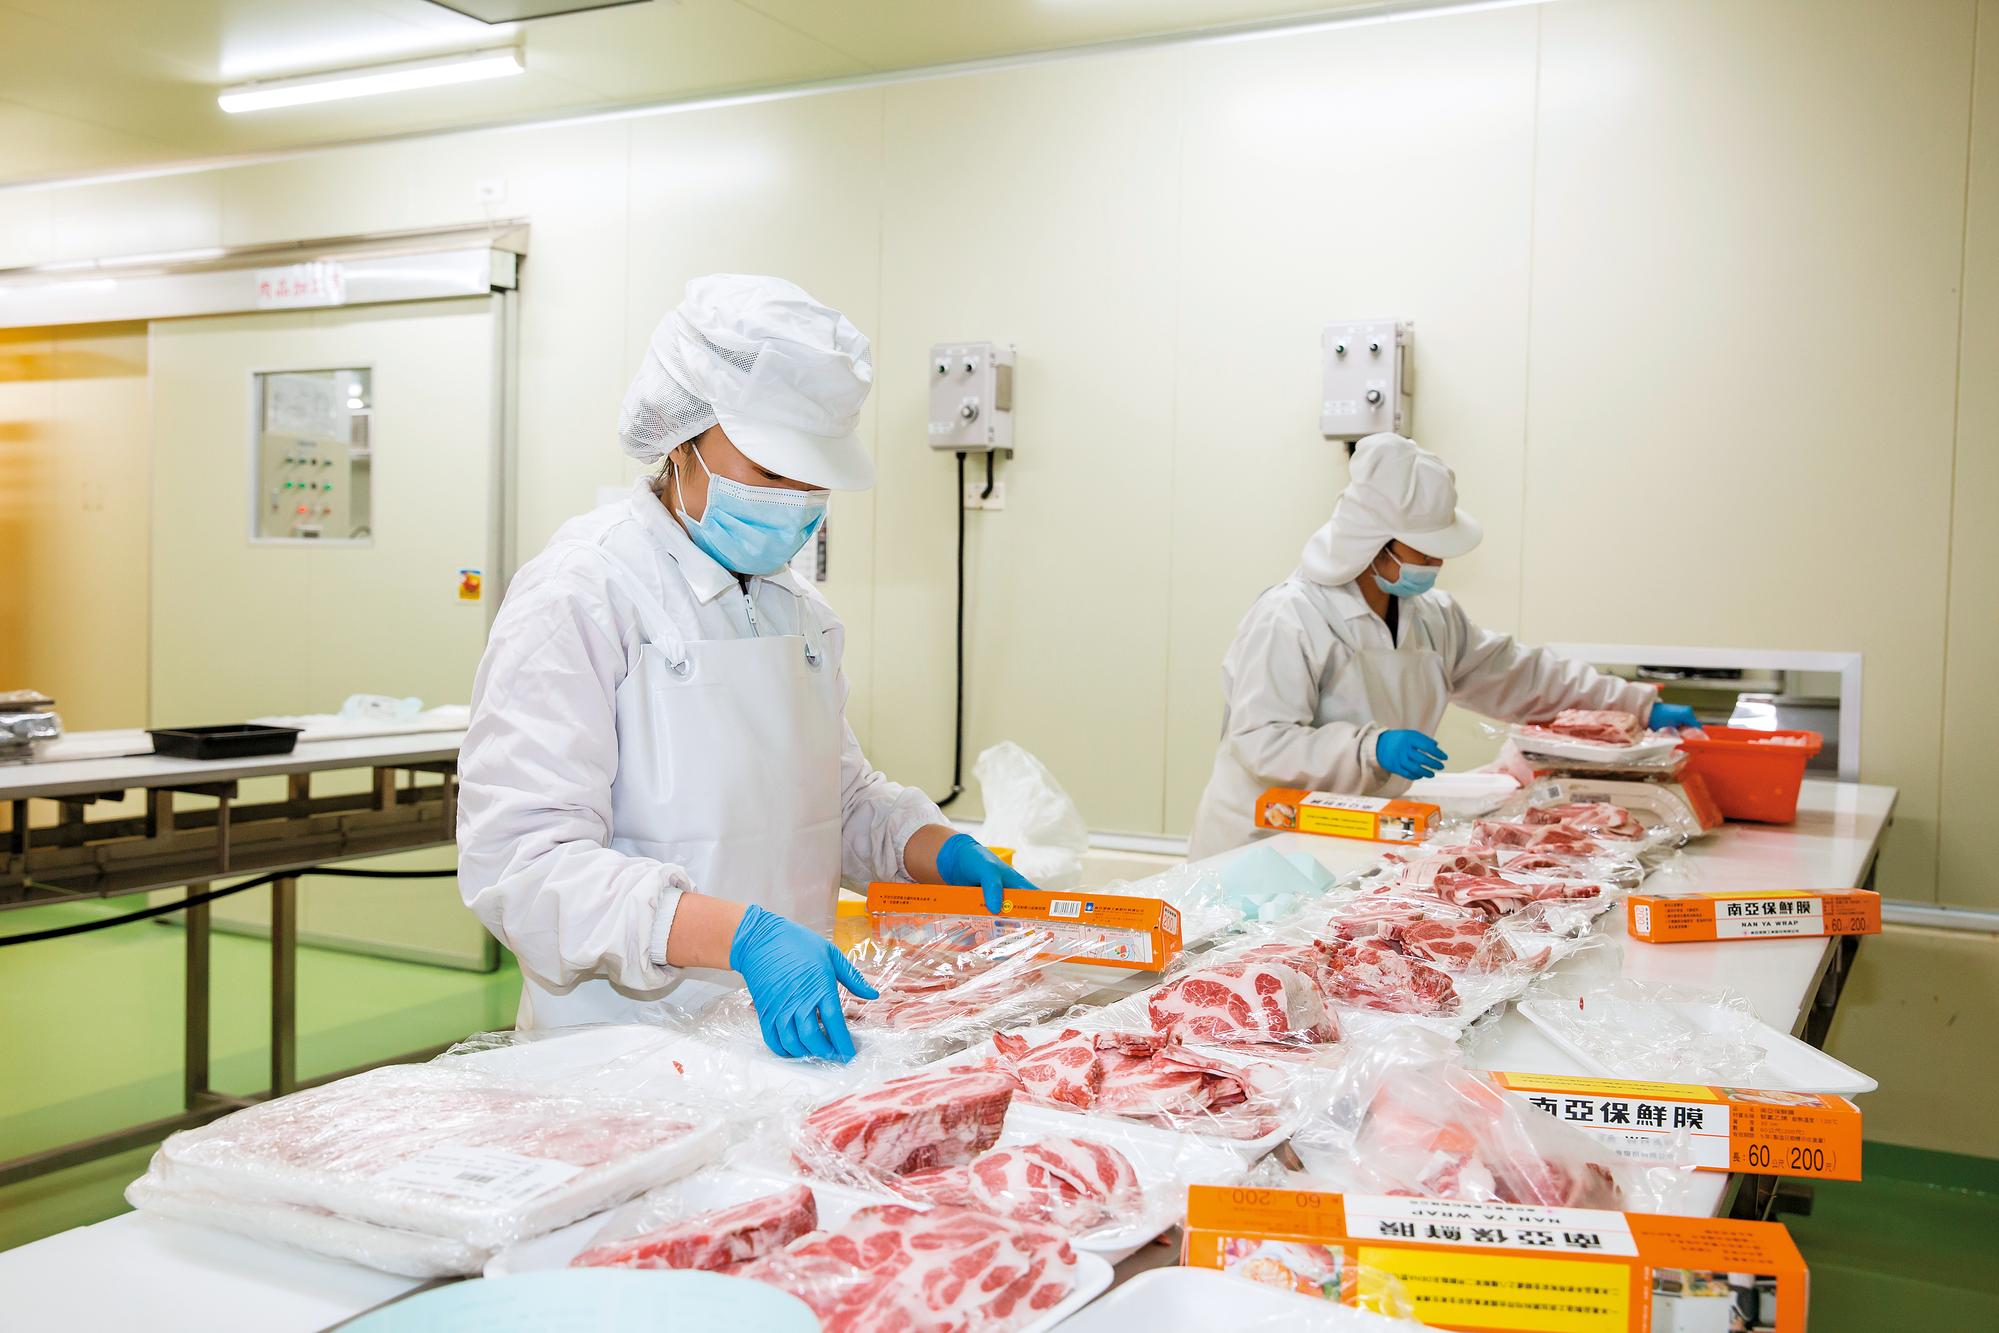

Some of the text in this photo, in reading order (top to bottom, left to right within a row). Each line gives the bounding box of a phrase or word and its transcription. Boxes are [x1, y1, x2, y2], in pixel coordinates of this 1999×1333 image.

[1727, 901, 1811, 916] 南亞保鮮膜
[1851, 918, 1866, 931] 200
[1380, 1220, 1602, 1249] 南亞保鮮膜
